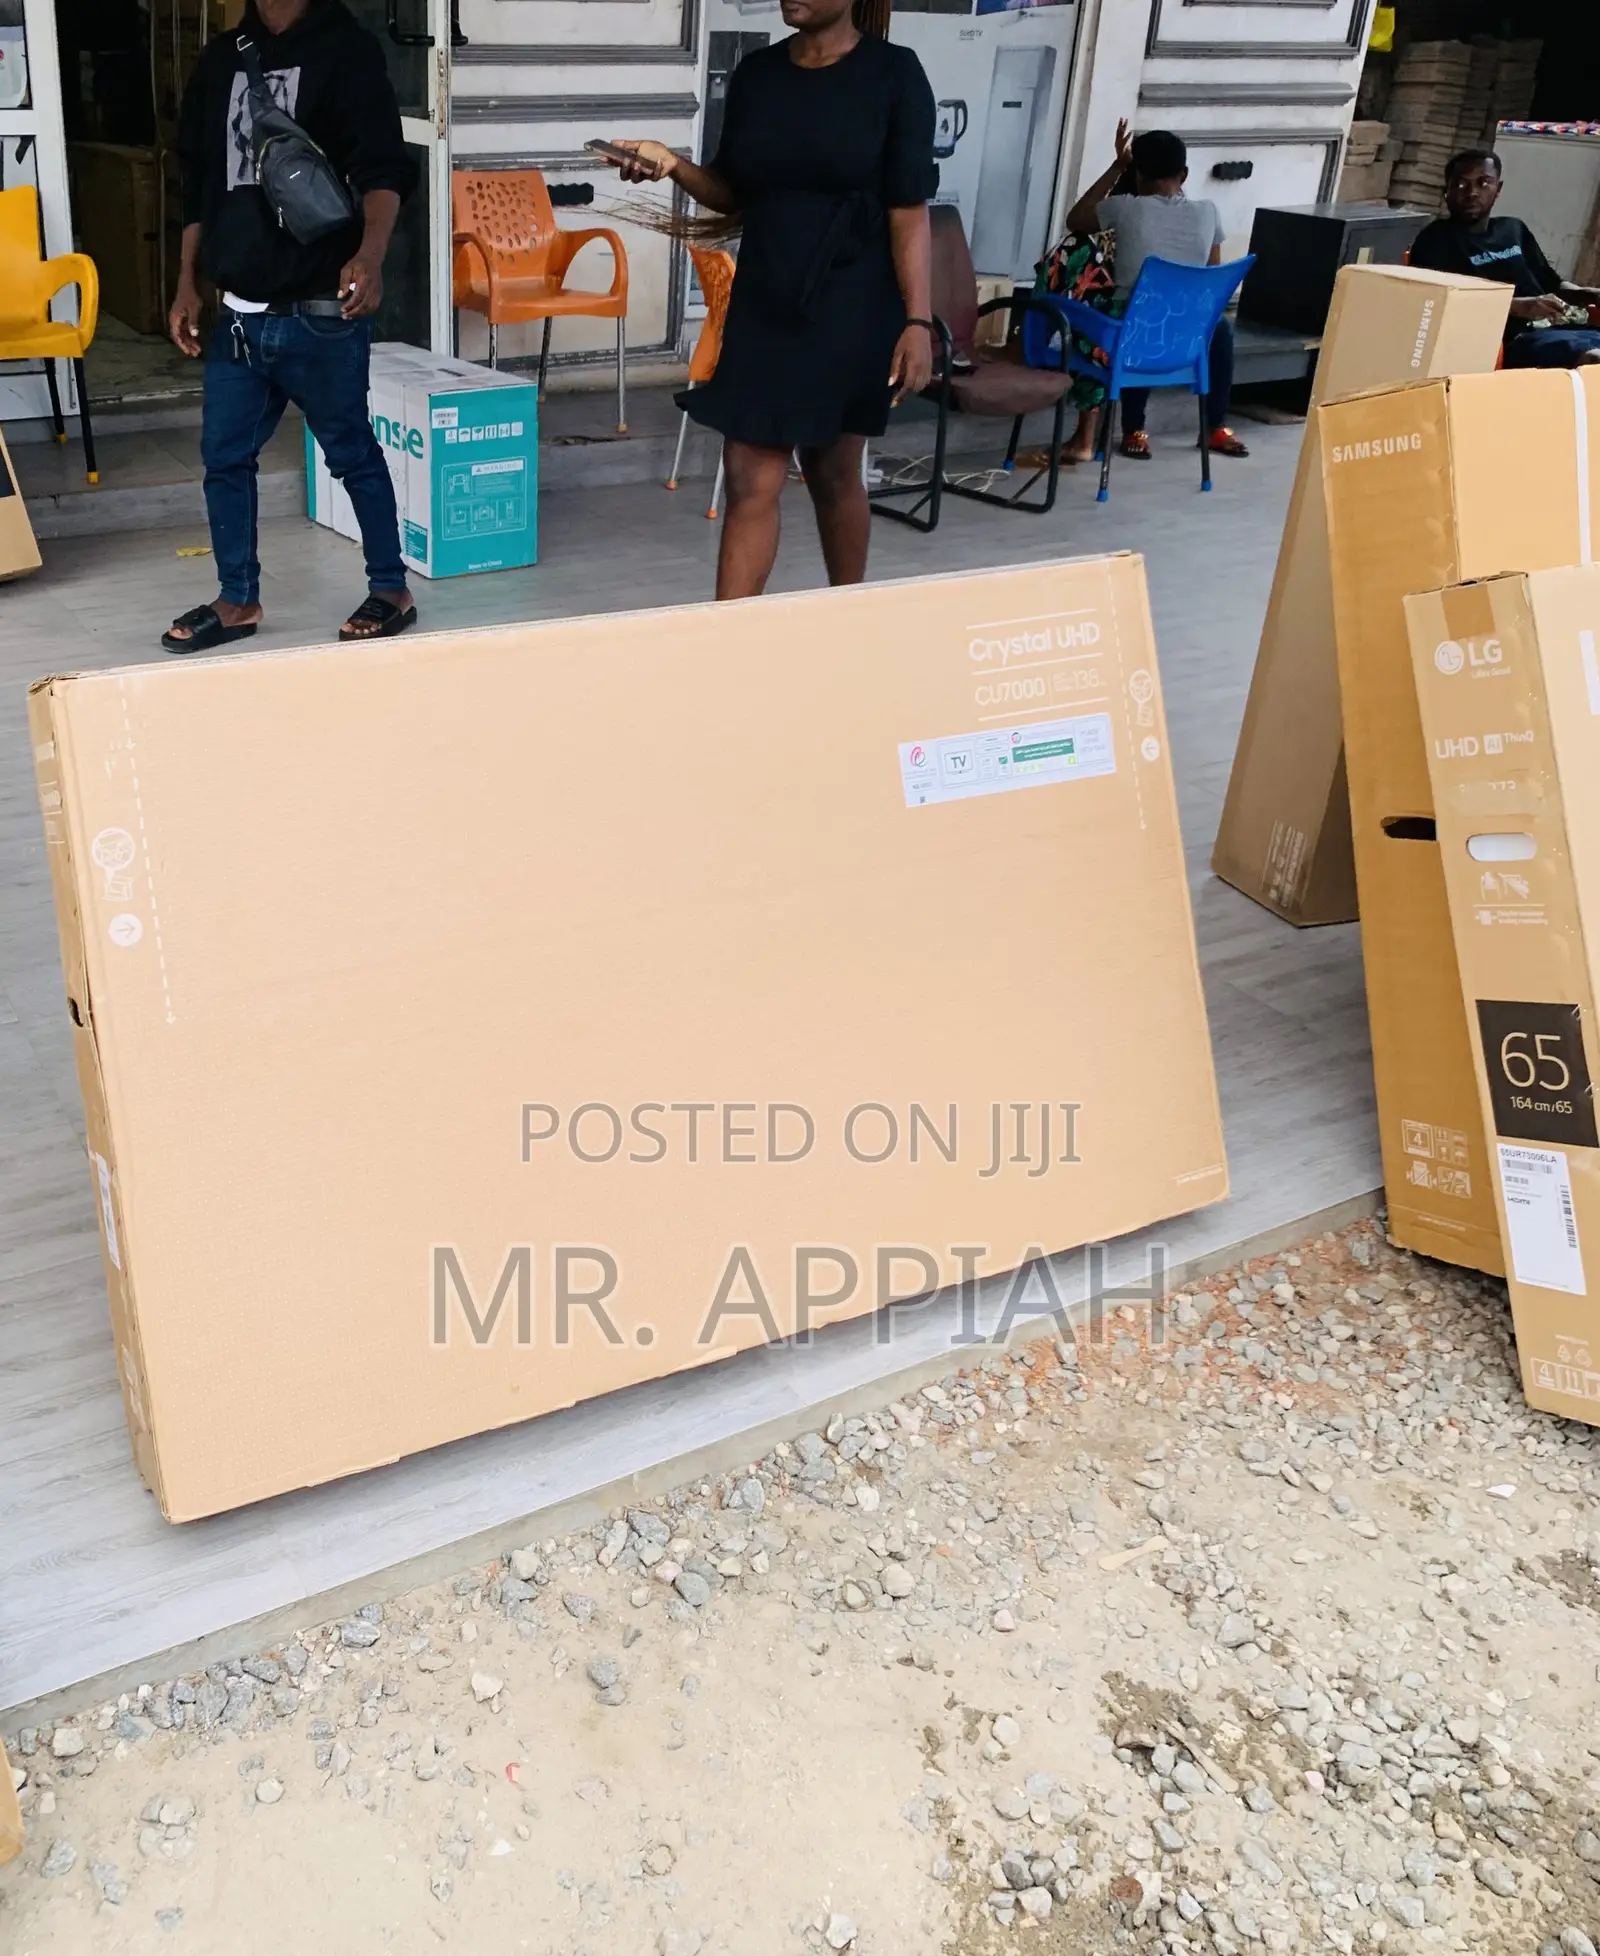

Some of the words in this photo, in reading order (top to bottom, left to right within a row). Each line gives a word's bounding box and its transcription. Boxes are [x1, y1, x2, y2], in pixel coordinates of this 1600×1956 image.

[1410, 299, 1435, 368] SAMSUNG
[1332, 432, 1422, 464] SAMSUNG
[969, 627, 1053, 668] Crystal
[1055, 621, 1100, 648] UHD
[1468, 639, 1503, 667] LG
[974, 677, 1046, 706] CU7000
[1435, 736, 1480, 758] UHD
[951, 755, 967, 769] TV
[1501, 1031, 1570, 1091] 65
[1510, 1096, 1533, 1110] 164
